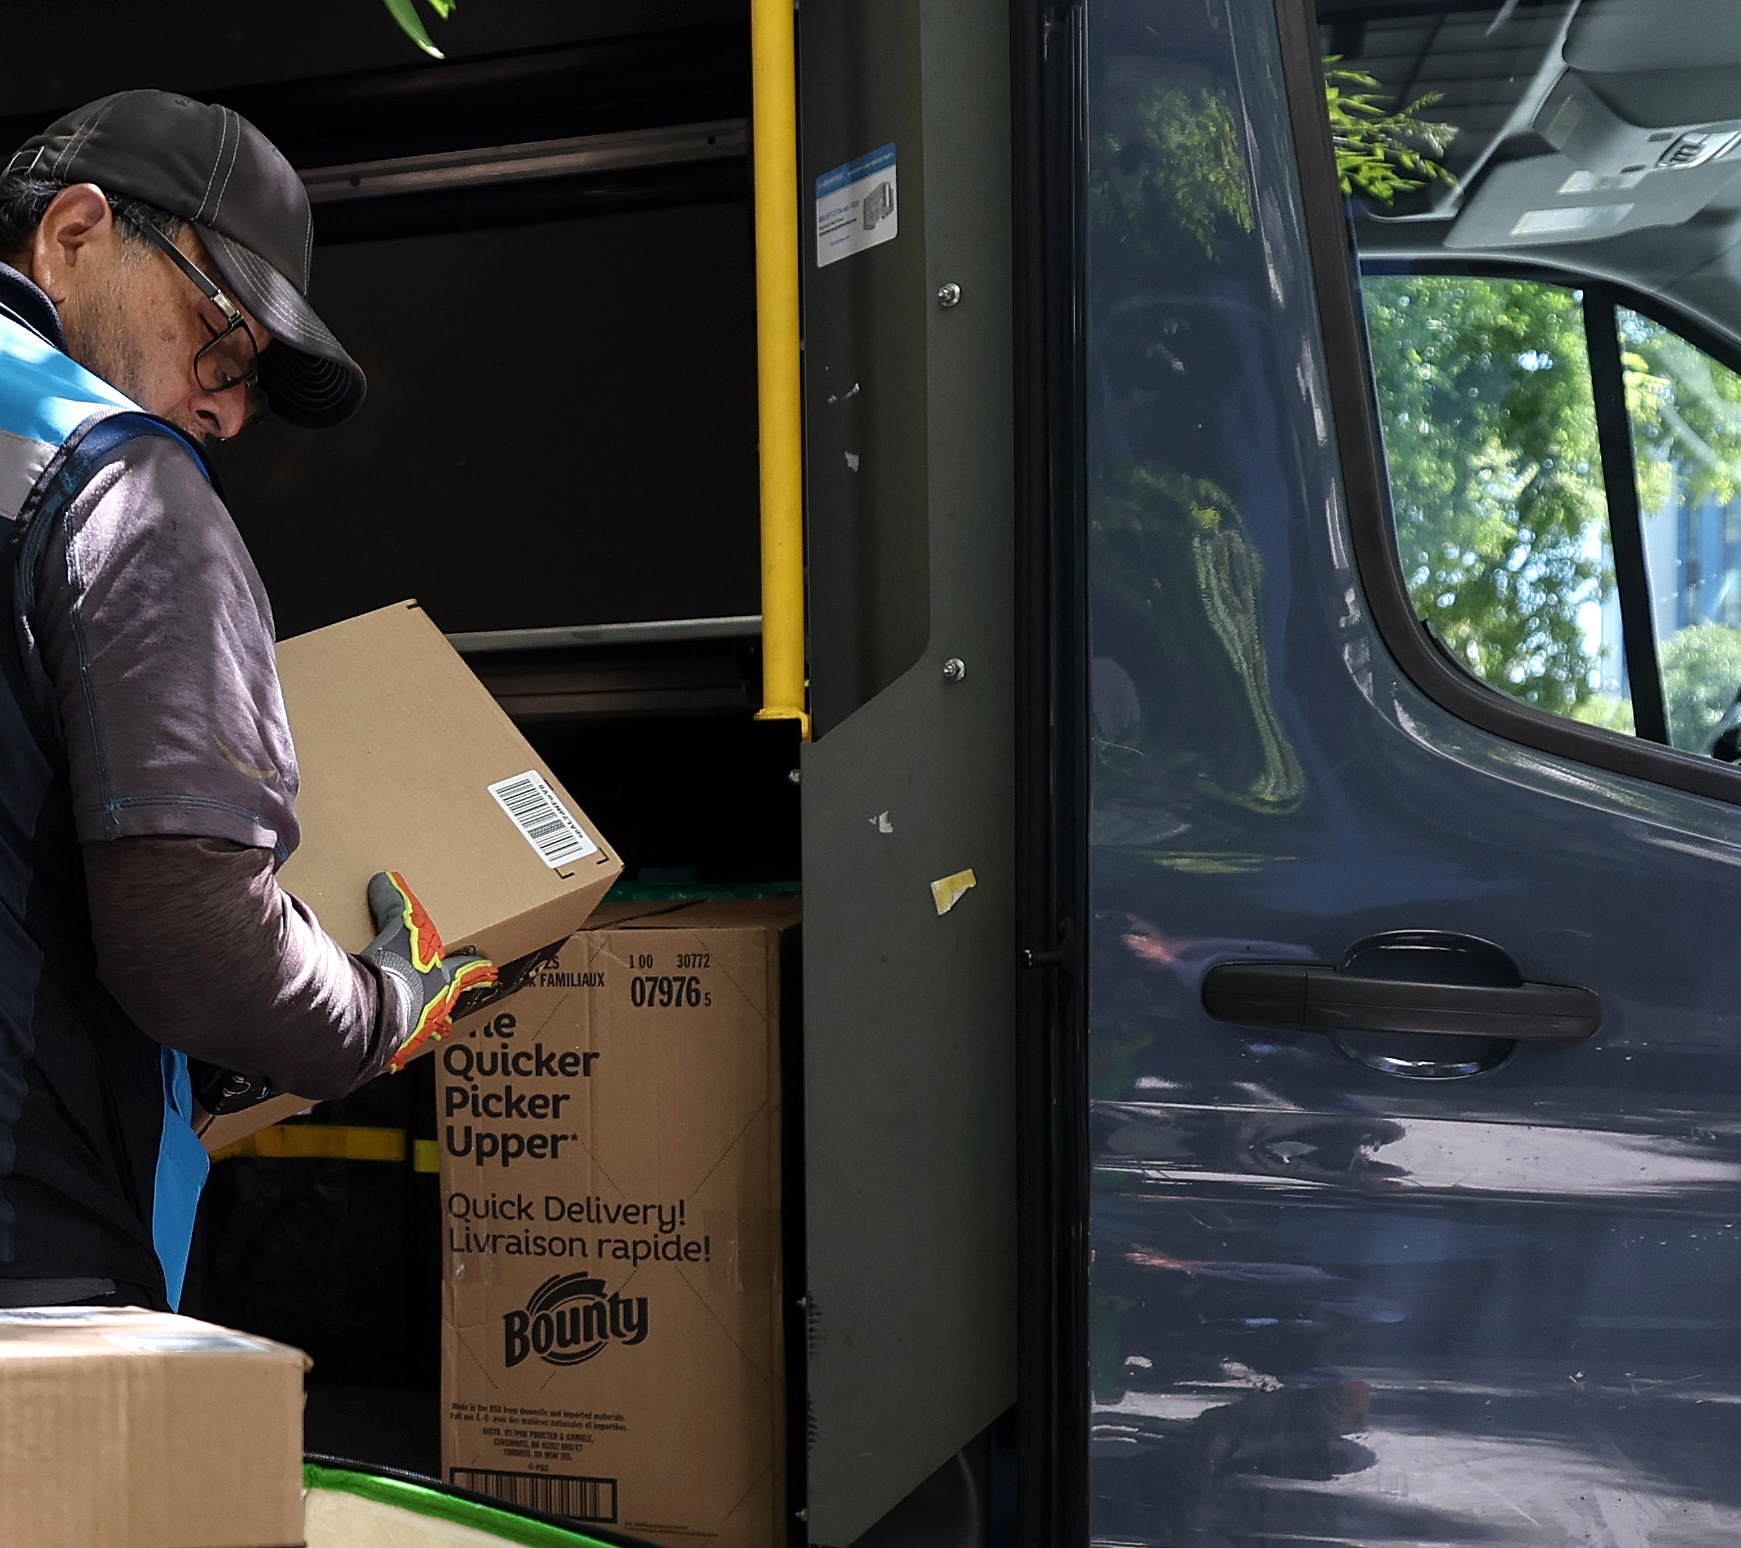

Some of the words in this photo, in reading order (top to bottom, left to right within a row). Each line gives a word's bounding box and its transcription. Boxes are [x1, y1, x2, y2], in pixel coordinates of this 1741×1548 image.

[676, 953, 711, 968] 30772
[540, 972, 605, 988] FAMILIAUX
[631, 976, 702, 1007] 07976
[443, 1042, 601, 1082] Quicker
[445, 1084, 571, 1119] Picker
[448, 1192, 535, 1222] Quick
[545, 1195, 686, 1235] Delivery!
[449, 1226, 589, 1258] Livraison
[598, 1234, 711, 1268] rapide!
[503, 1292, 649, 1368] Bounty
